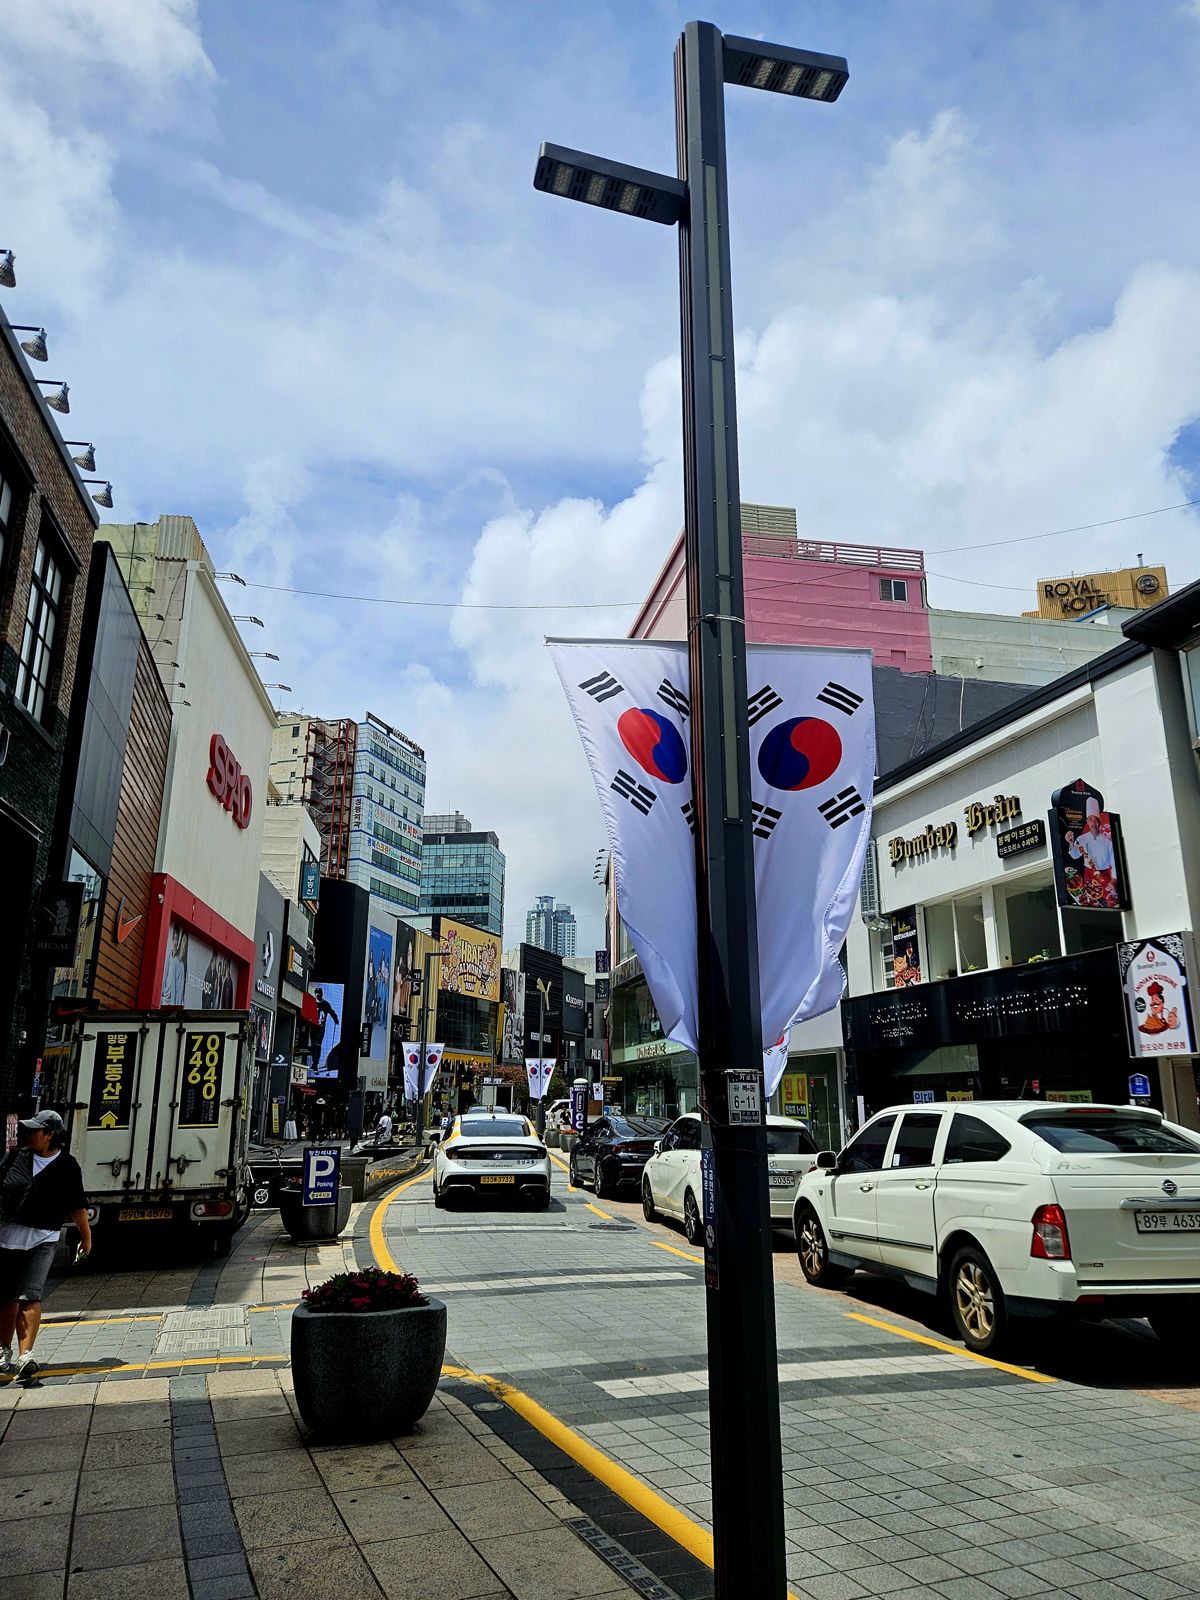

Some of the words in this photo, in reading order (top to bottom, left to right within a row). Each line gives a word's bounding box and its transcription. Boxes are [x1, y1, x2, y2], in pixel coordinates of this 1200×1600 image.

[1044, 578, 1101, 599] ROYAL
[206, 733, 252, 830] SPAO
[888, 820, 958, 868] Bombay
[964, 794, 1022, 838] Bräu
[256, 978, 276, 999] CONVERSE
[102, 1045, 125, 1100] 부동산
[734, 1095, 756, 1109] 6-11
[309, 1155, 335, 1188] P
[772, 1176, 791, 1185] 5035
[1143, 1214, 1168, 1229] 89루
